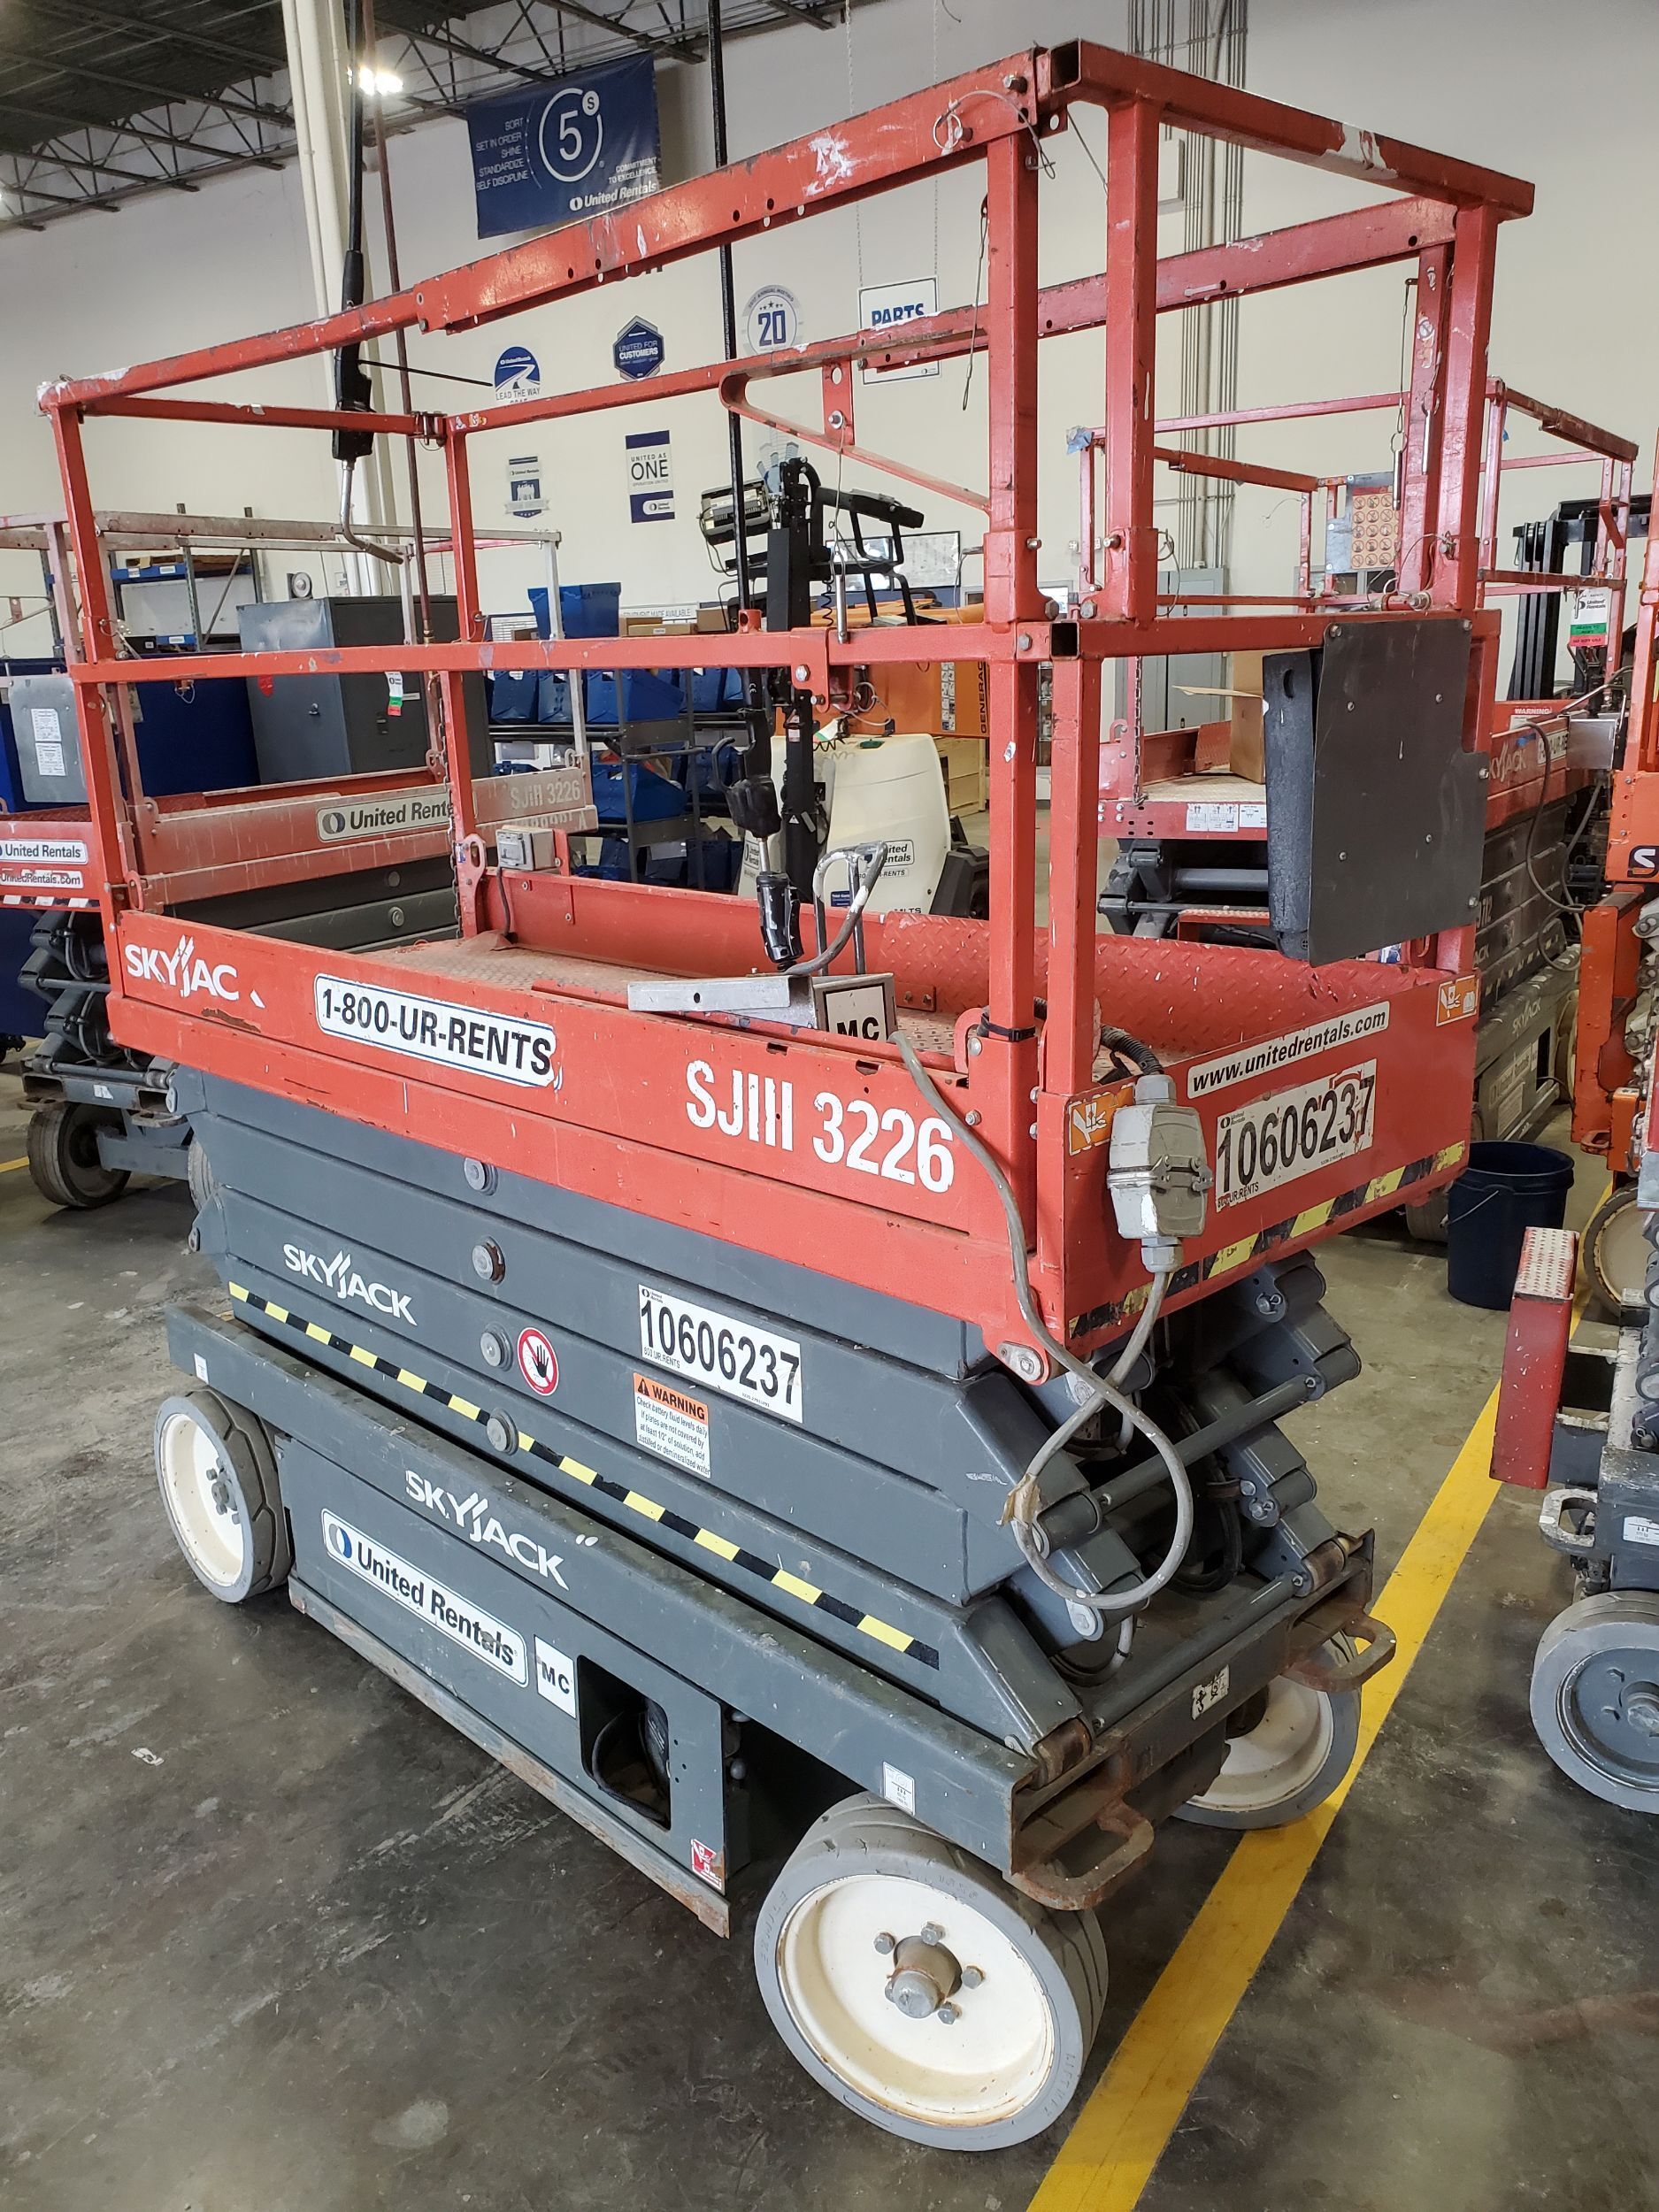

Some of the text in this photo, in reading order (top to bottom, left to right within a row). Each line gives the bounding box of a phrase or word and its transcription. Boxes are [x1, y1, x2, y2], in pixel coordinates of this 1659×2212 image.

[504, 117, 524, 132] SORT
[559, 110, 582, 161] 5
[476, 132, 522, 152] SET IN ORDER
[501, 145, 522, 158] SHINE
[479, 157, 525, 178] STANDARDIZE
[615, 157, 657, 173] COMMITMENT
[618, 166, 657, 182] EXCELLENCE
[476, 170, 529, 191] SELF DISCIPLINE
[584, 180, 657, 208] United Rentals
[757, 310, 787, 347] 20
[872, 303, 925, 326] PARTS
[619, 340, 657, 352] UNITED FOR
[619, 347, 659, 360] CUSTOMERS
[495, 391, 512, 401] LEAD
[513, 388, 526, 398] THE
[526, 388, 541, 396] WAY
[631, 453, 656, 463] UNITED
[631, 458, 669, 481] ONE
[977, 661, 987, 734] GENERAC
[1489, 741, 1528, 783] KYJACK
[546, 780, 581, 805] 3226
[349, 798, 455, 830] United Rent
[4, 843, 81, 858] United Rentals
[885, 853, 911, 864] entals
[887, 843, 908, 853] ited
[125, 934, 265, 1009] SKYJAC
[321, 987, 553, 1077] 1-800-UR-RENTS
[836, 1016, 880, 1041] MC
[1193, 1010, 1386, 1093] www.unitedrentals.com
[811, 1091, 956, 1194] 3226
[1217, 1073, 1375, 1194] 10606237
[282, 1242, 419, 1326] SKYJACK
[641, 1299, 801, 1406] 10606237
[637, 1396, 708, 1439] Check battery fluid levels daily
[652, 1384, 705, 1421] WARNING
[645, 1413, 659, 1426] plates
[668, 1424, 677, 1434] not
[677, 1429, 697, 1445] covered
[697, 1436, 705, 1449] by
[645, 1424, 657, 1438] least
[667, 1436, 673, 1445] of
[673, 1439, 695, 1457] solution,
[695, 1450, 705, 1461] add
[663, 1446, 696, 1469] demineralized
[696, 1462, 711, 1476] water
[405, 1470, 571, 1592] SKYJACK
[357, 1541, 515, 1668] United Rentals
[541, 1661, 570, 1694] MC
